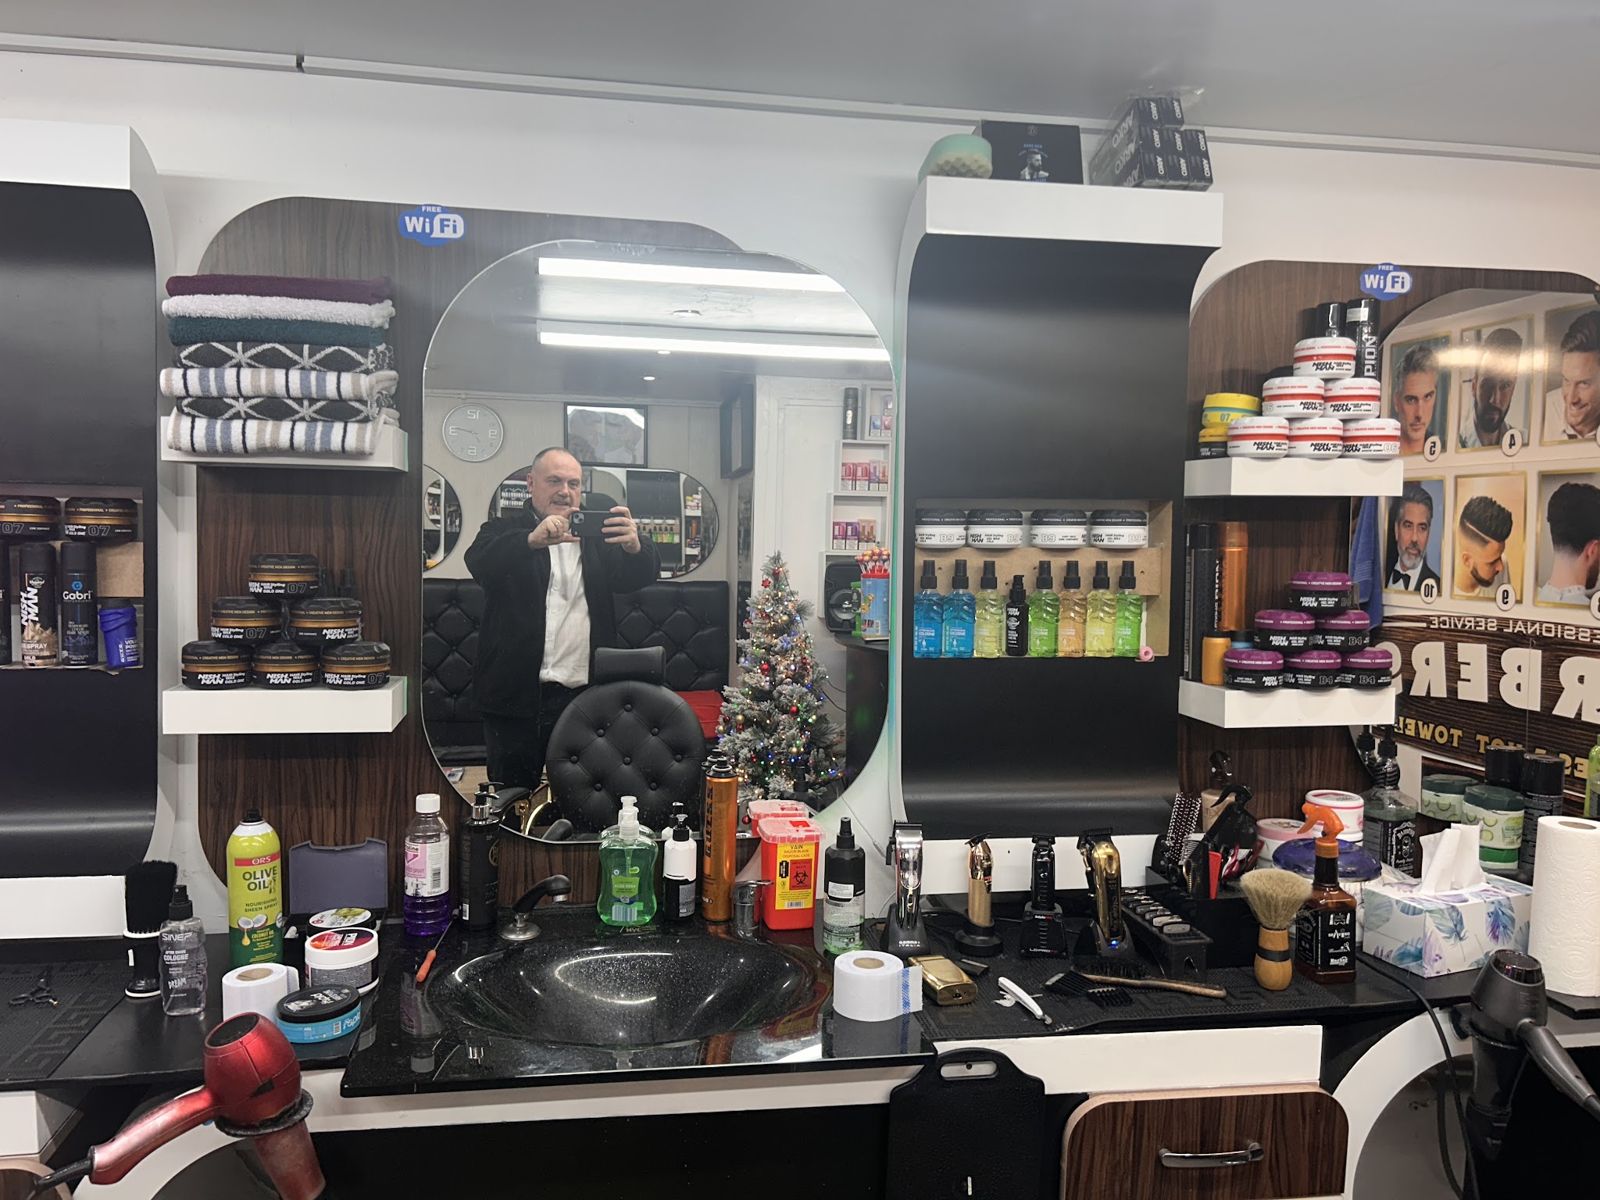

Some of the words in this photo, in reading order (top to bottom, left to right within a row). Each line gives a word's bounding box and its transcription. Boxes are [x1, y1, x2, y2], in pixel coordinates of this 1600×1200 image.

[2, 523, 24, 533] 07
[88, 526, 110, 536] 07
[287, 583, 307, 593] 07
[63, 591, 91, 600] Gabri
[20, 592, 28, 626] NISH
[27, 587, 38, 621] MAN
[246, 628, 266, 638] 07
[1320, 676, 1333, 684] B4
[1359, 675, 1375, 684] B4
[252, 856, 271, 865] ORS
[242, 866, 277, 881] OLIVE
[247, 880, 269, 891] OIL
